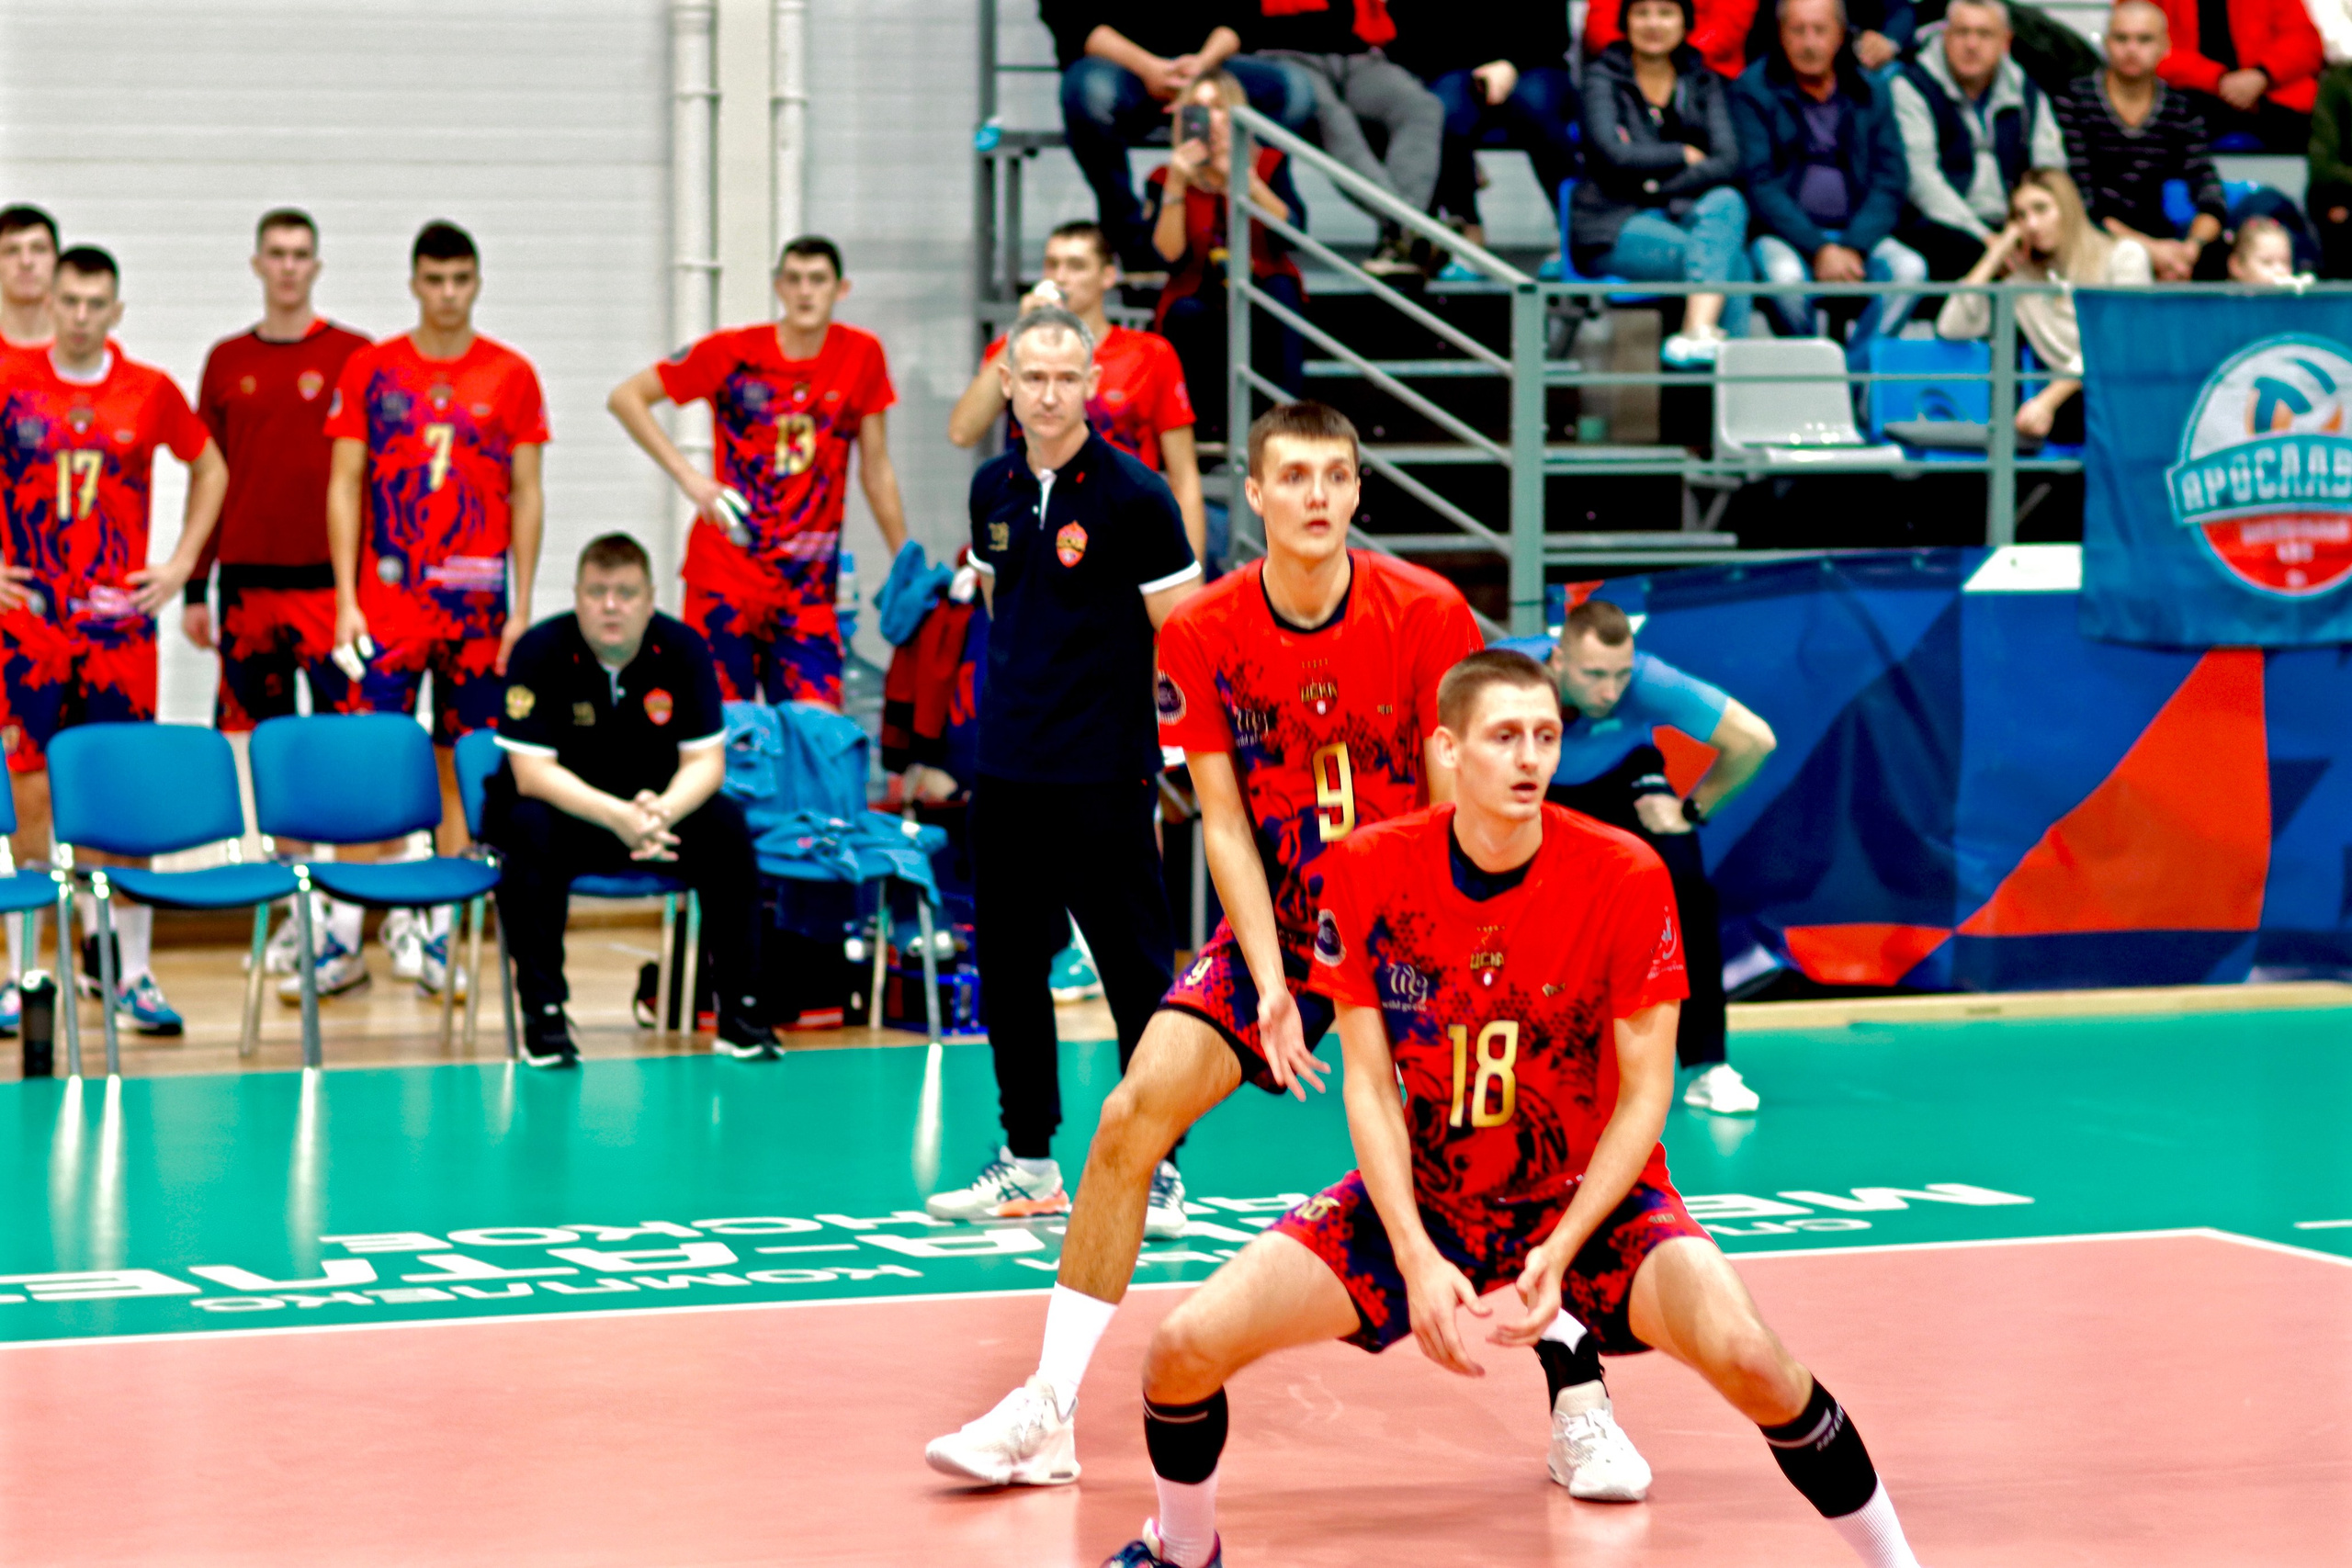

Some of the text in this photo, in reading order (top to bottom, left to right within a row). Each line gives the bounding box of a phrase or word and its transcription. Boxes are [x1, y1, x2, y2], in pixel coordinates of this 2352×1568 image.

[425, 423, 455, 491] 7
[774, 414, 817, 476] 13
[55, 449, 103, 520] 17
[1313, 741, 1355, 842] 9
[1185, 956, 1213, 986] 9
[1448, 1020, 1519, 1128] 18
[190, 1262, 924, 1313] КОМПЛЕКС
